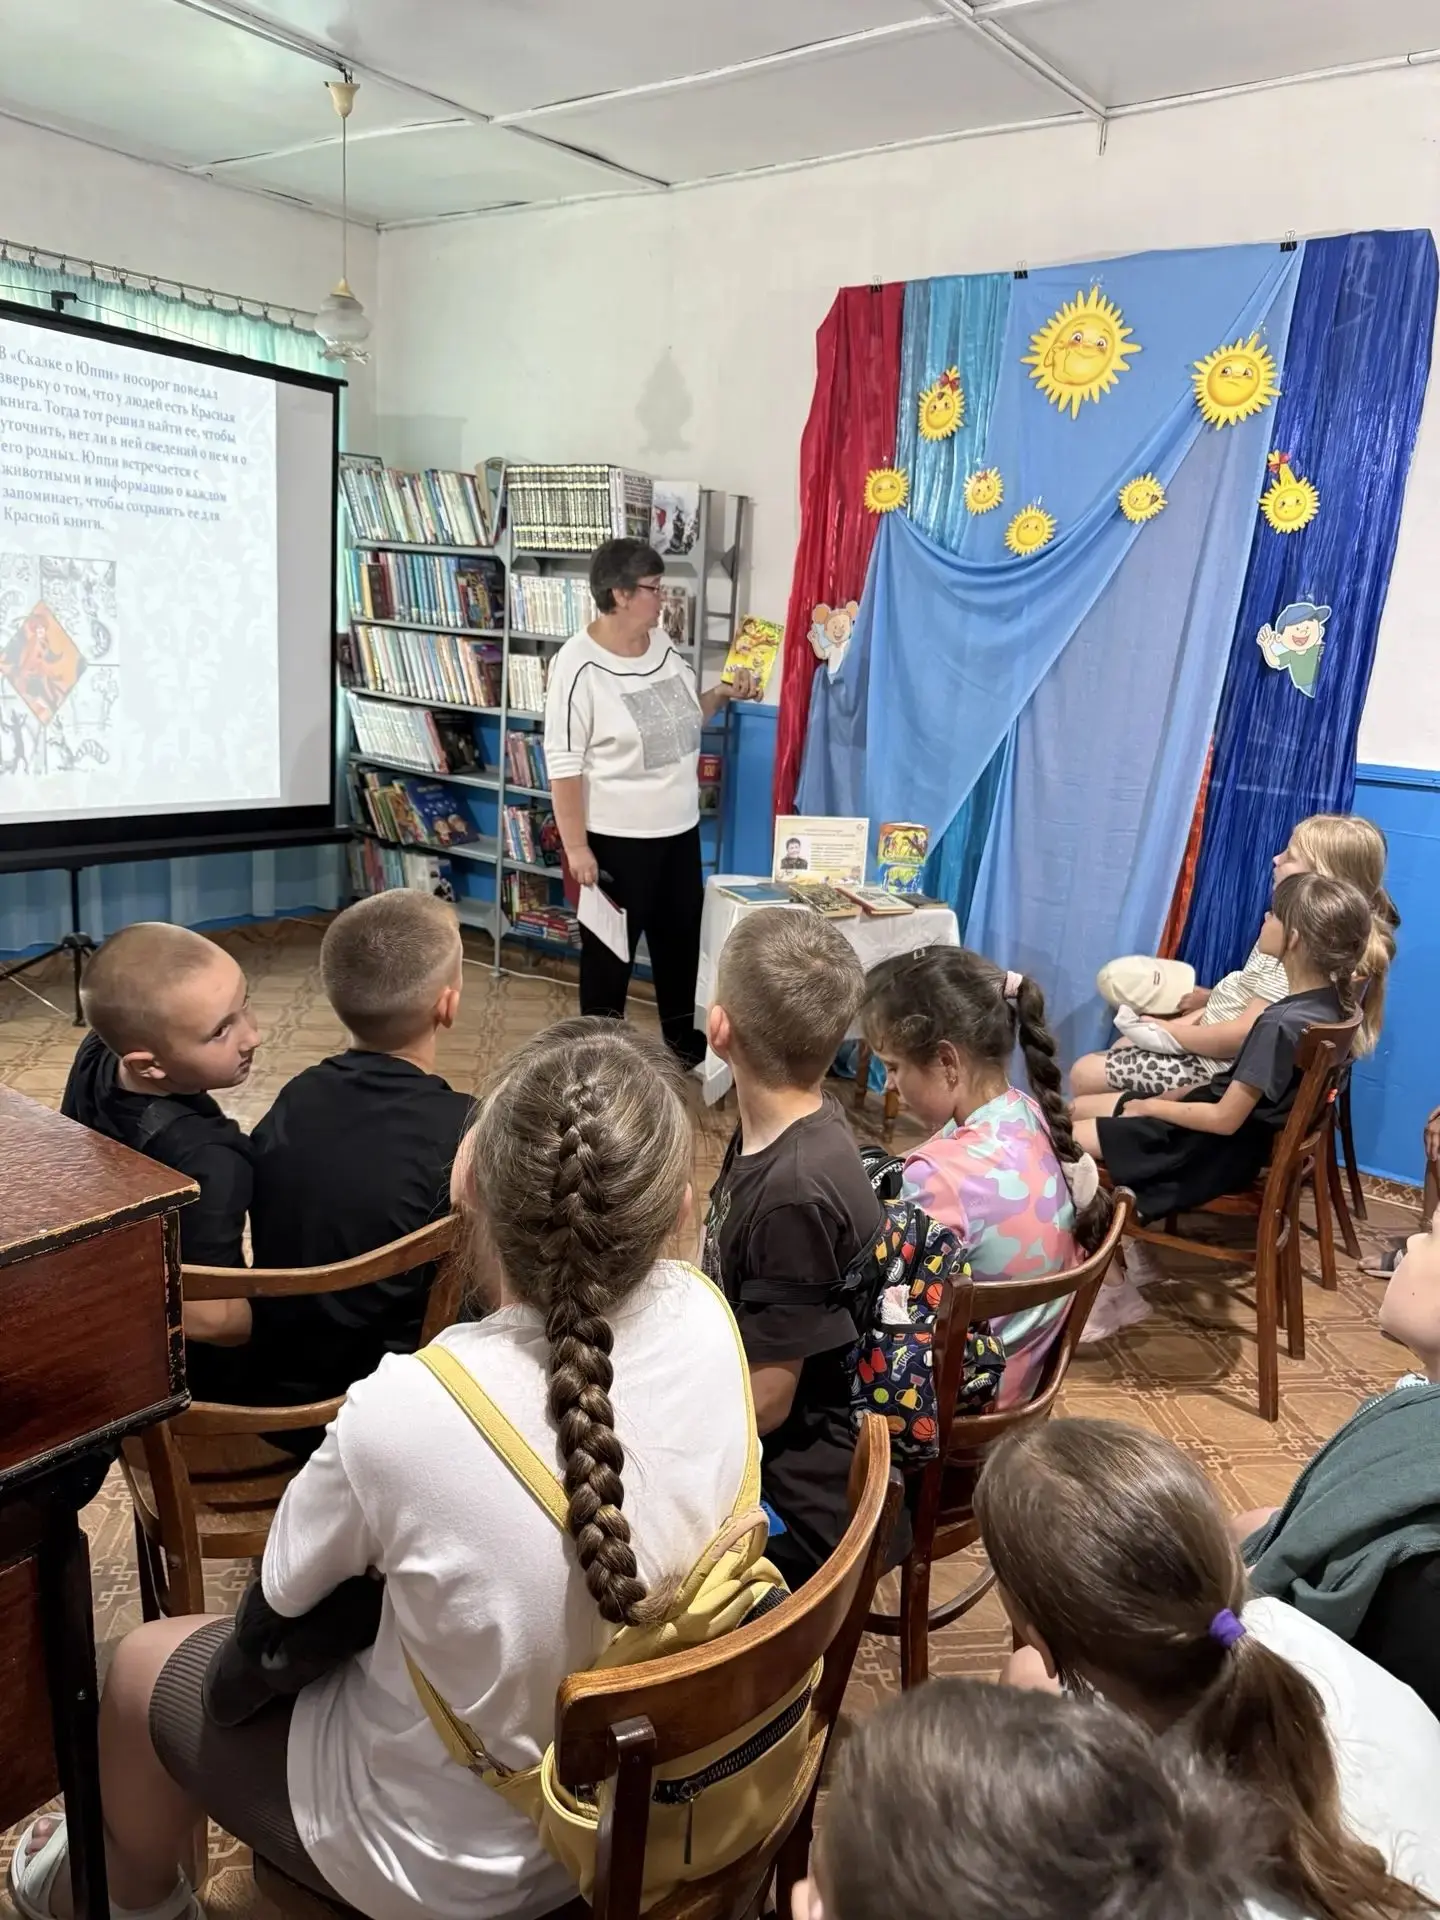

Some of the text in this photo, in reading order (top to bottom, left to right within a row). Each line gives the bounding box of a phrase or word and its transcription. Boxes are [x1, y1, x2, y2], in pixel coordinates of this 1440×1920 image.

[10, 348, 62, 371] «Сказке
[65, 362, 73, 372] о
[76, 360, 120, 380] Юппи»
[123, 372, 170, 392] носорог
[173, 382, 218, 400] поведал
[0, 372, 236, 423] зверьку о том, что у людей есть Красная
[0, 396, 236, 444] книга. Тогда тот решил найти ее, чтобы
[0, 418, 248, 466] уточнить, нет ли в ней сведений о нем и о
[0, 441, 199, 480] его родных. Юппи встречается с
[2, 464, 227, 502] животными и информацию о каждом
[2, 486, 220, 522] запоминает, чтобы сохранить ее для
[4, 505, 105, 530] Красной книги.
